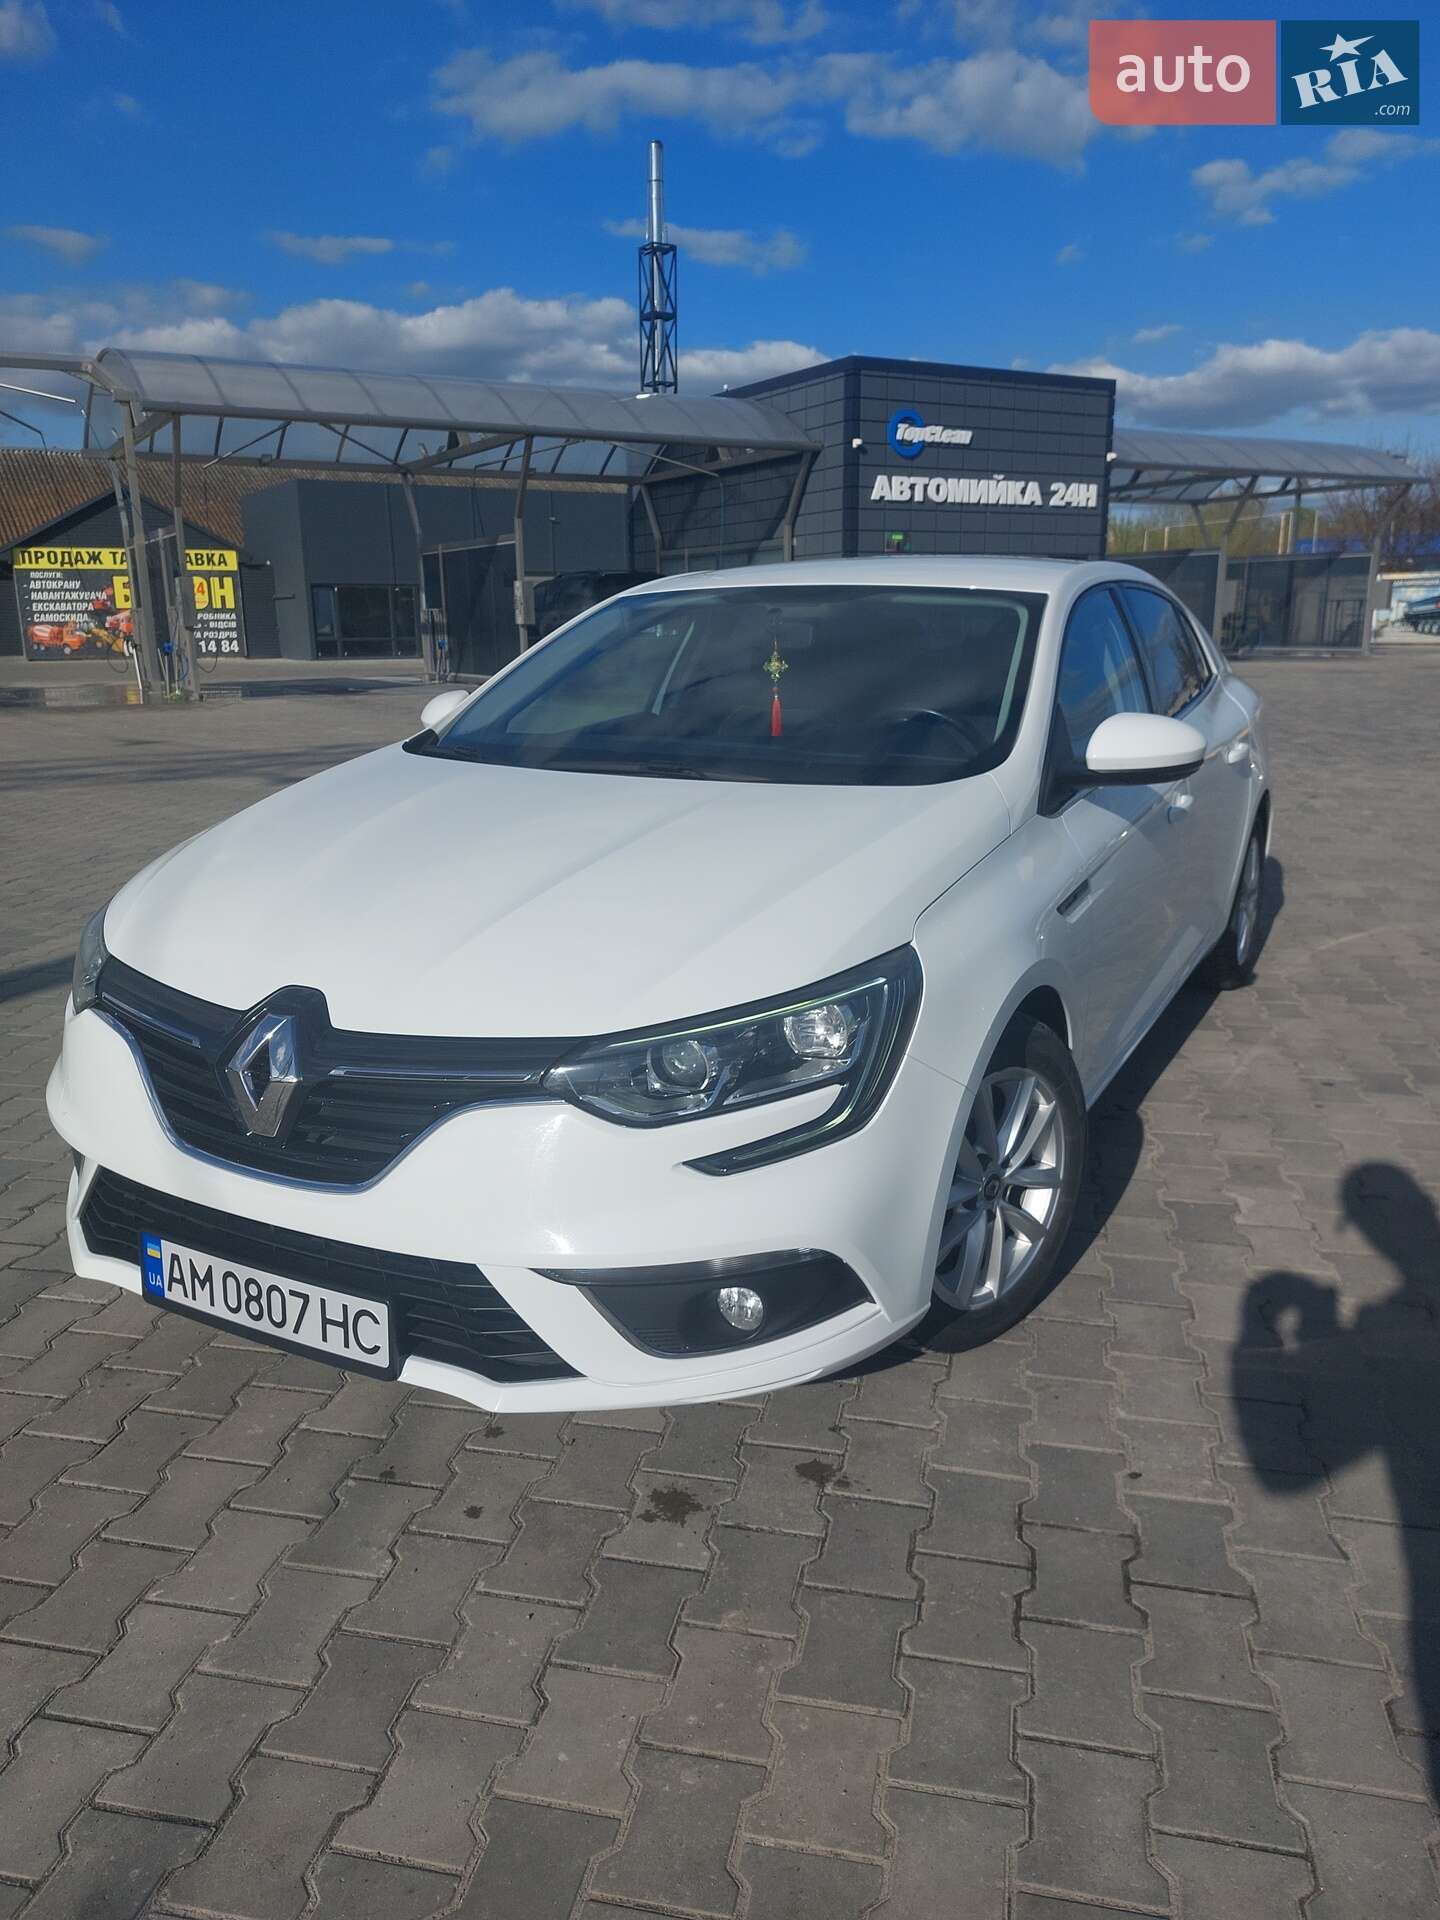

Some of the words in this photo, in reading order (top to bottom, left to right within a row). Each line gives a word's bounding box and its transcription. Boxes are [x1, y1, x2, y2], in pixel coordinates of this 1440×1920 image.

[896, 422, 973, 445] TopClean
[871, 474, 1043, 506] АВТОМИЙКА
[20, 550, 103, 567] ПРОДАЖ
[185, 552, 228, 567] АВКА
[29, 580, 81, 590] АВТОКРАНУ
[32, 602, 95, 612] ЕКСКАВАТОРА
[198, 640, 218, 653] 14
[221, 640, 240, 653] 84
[149, 1271, 163, 1289] UA
[167, 1253, 215, 1307] AM
[222, 1271, 310, 1335] 0807
[319, 1297, 381, 1355] HC
